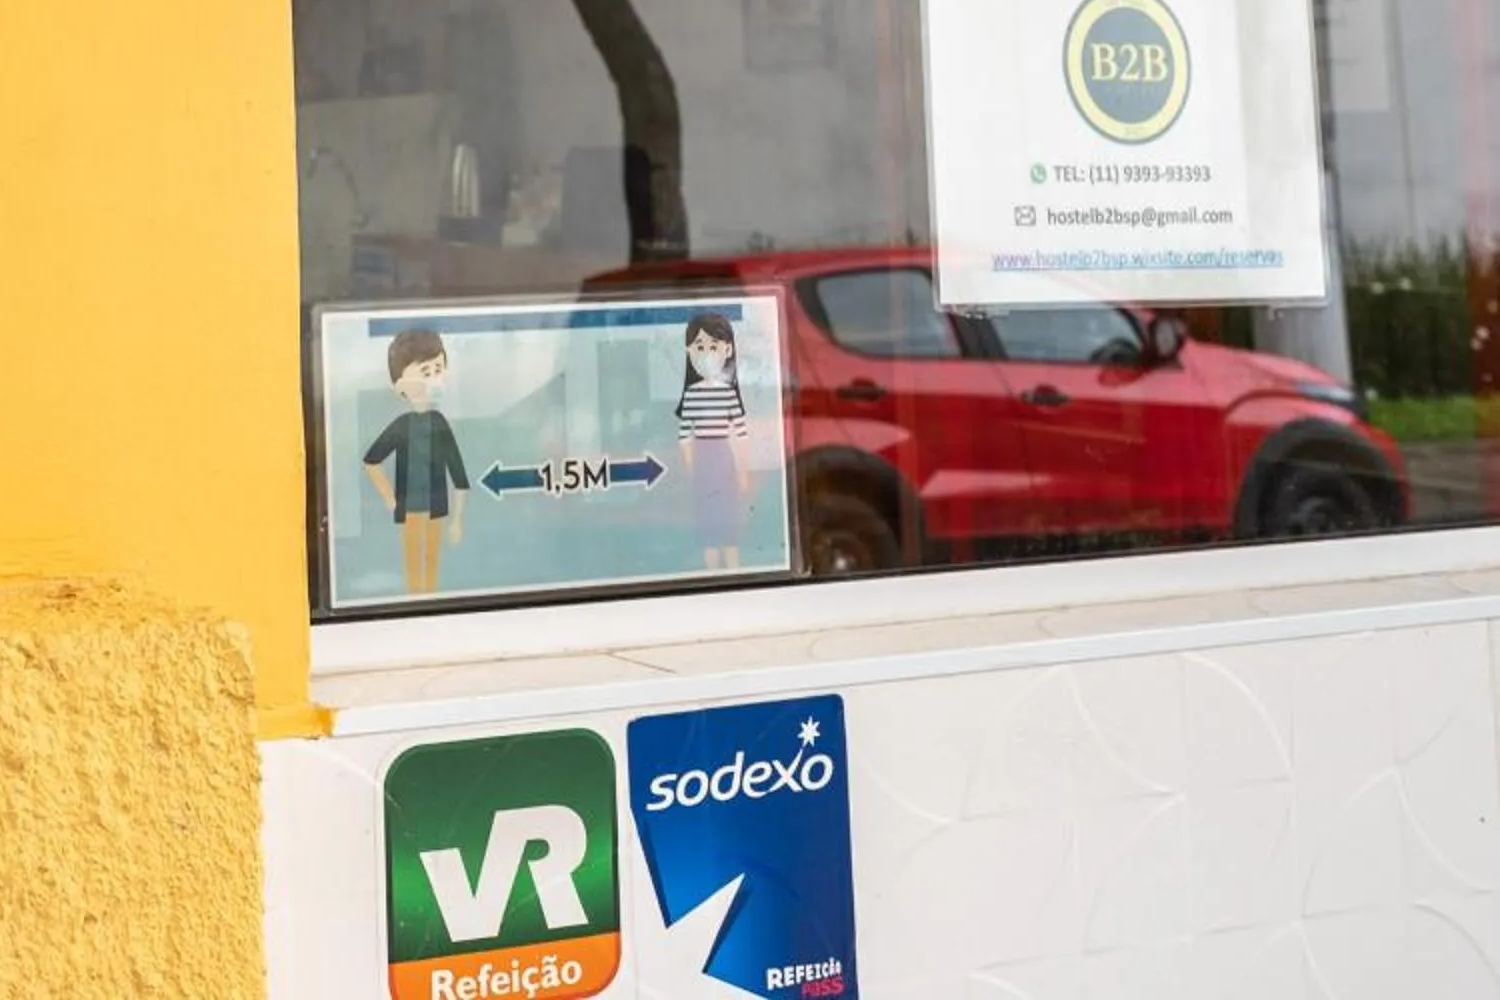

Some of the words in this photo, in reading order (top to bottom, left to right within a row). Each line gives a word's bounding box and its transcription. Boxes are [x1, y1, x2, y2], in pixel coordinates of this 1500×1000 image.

[1091, 42, 1169, 82] B2B
[1053, 165, 1086, 183] TEL:
[1089, 164, 1119, 185] (11)
[1046, 206, 1233, 228] hostelb2bsp@gmail.com
[541, 459, 610, 494] 1,5M
[646, 750, 833, 811] sodexo
[431, 954, 582, 1000] Refeição
